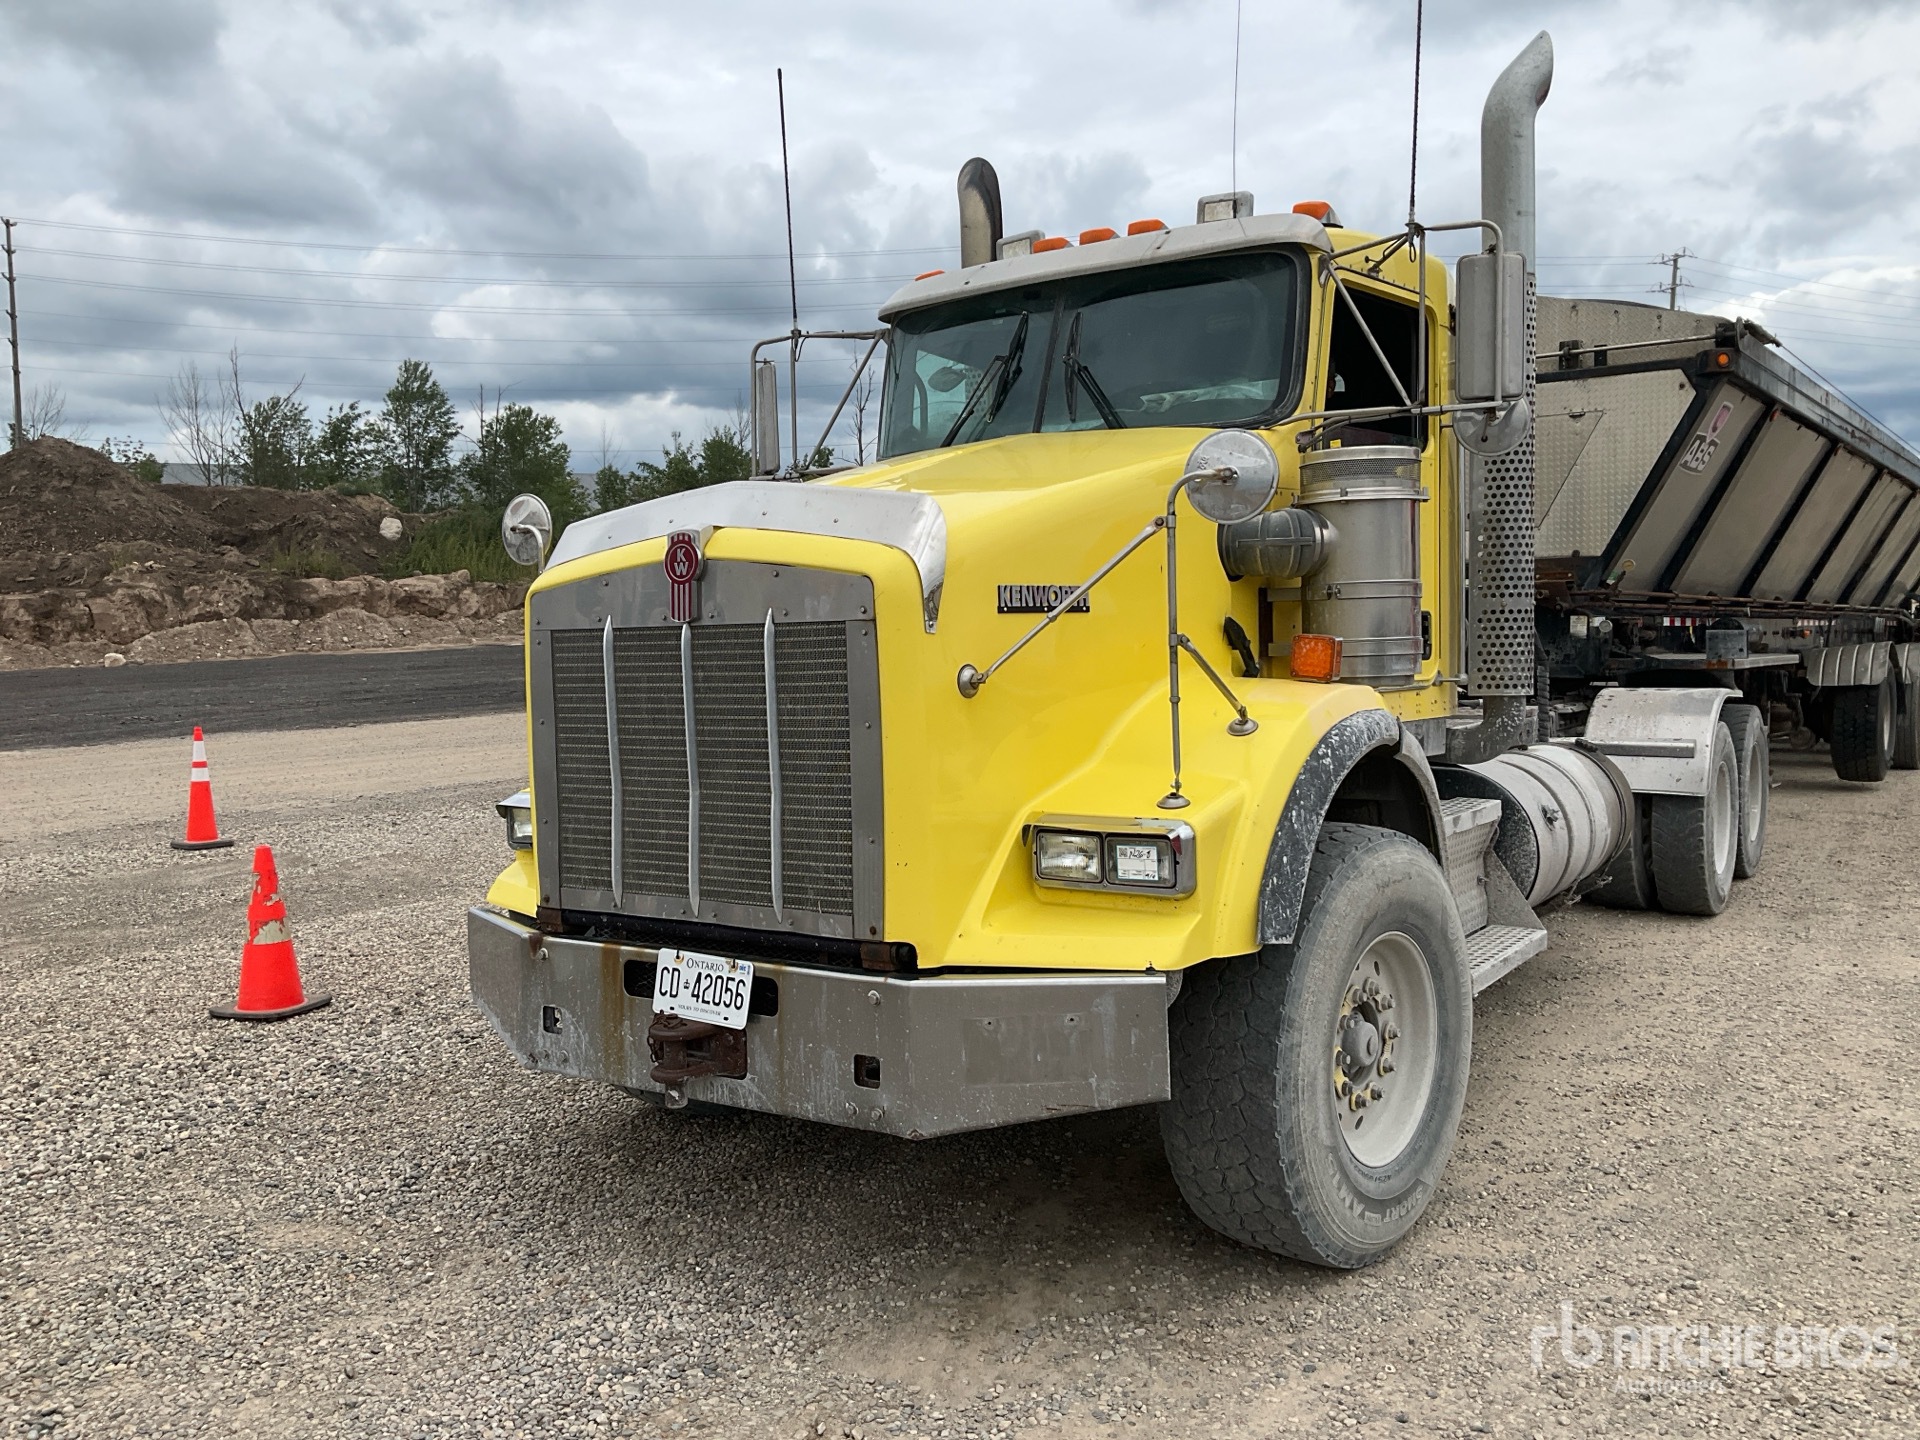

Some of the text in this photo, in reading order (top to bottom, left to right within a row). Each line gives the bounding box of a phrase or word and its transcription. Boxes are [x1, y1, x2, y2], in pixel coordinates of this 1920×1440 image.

[1681, 439, 1715, 471] ABS
[686, 958, 724, 973] ONTARIO
[659, 966, 746, 1011] CD 42056
